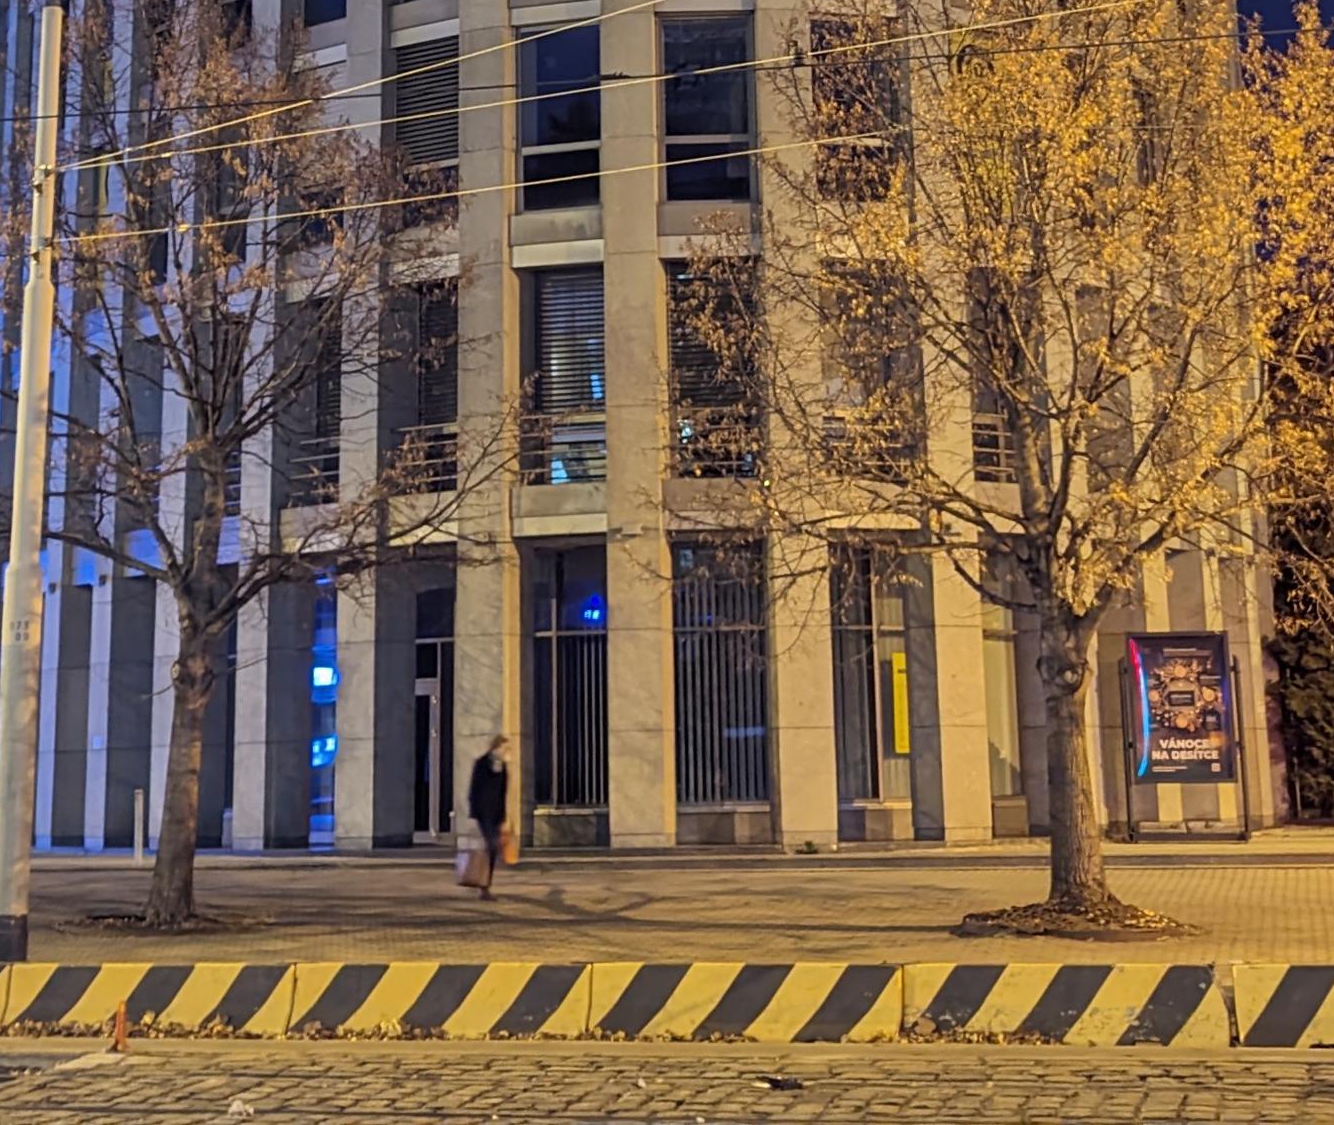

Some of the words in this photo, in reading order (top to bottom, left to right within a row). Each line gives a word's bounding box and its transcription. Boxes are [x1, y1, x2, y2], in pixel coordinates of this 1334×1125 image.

[1159, 737, 1210, 749] VÁNOCE
[1151, 750, 1170, 760] NA
[1171, 749, 1219, 760] DESÍTCE
